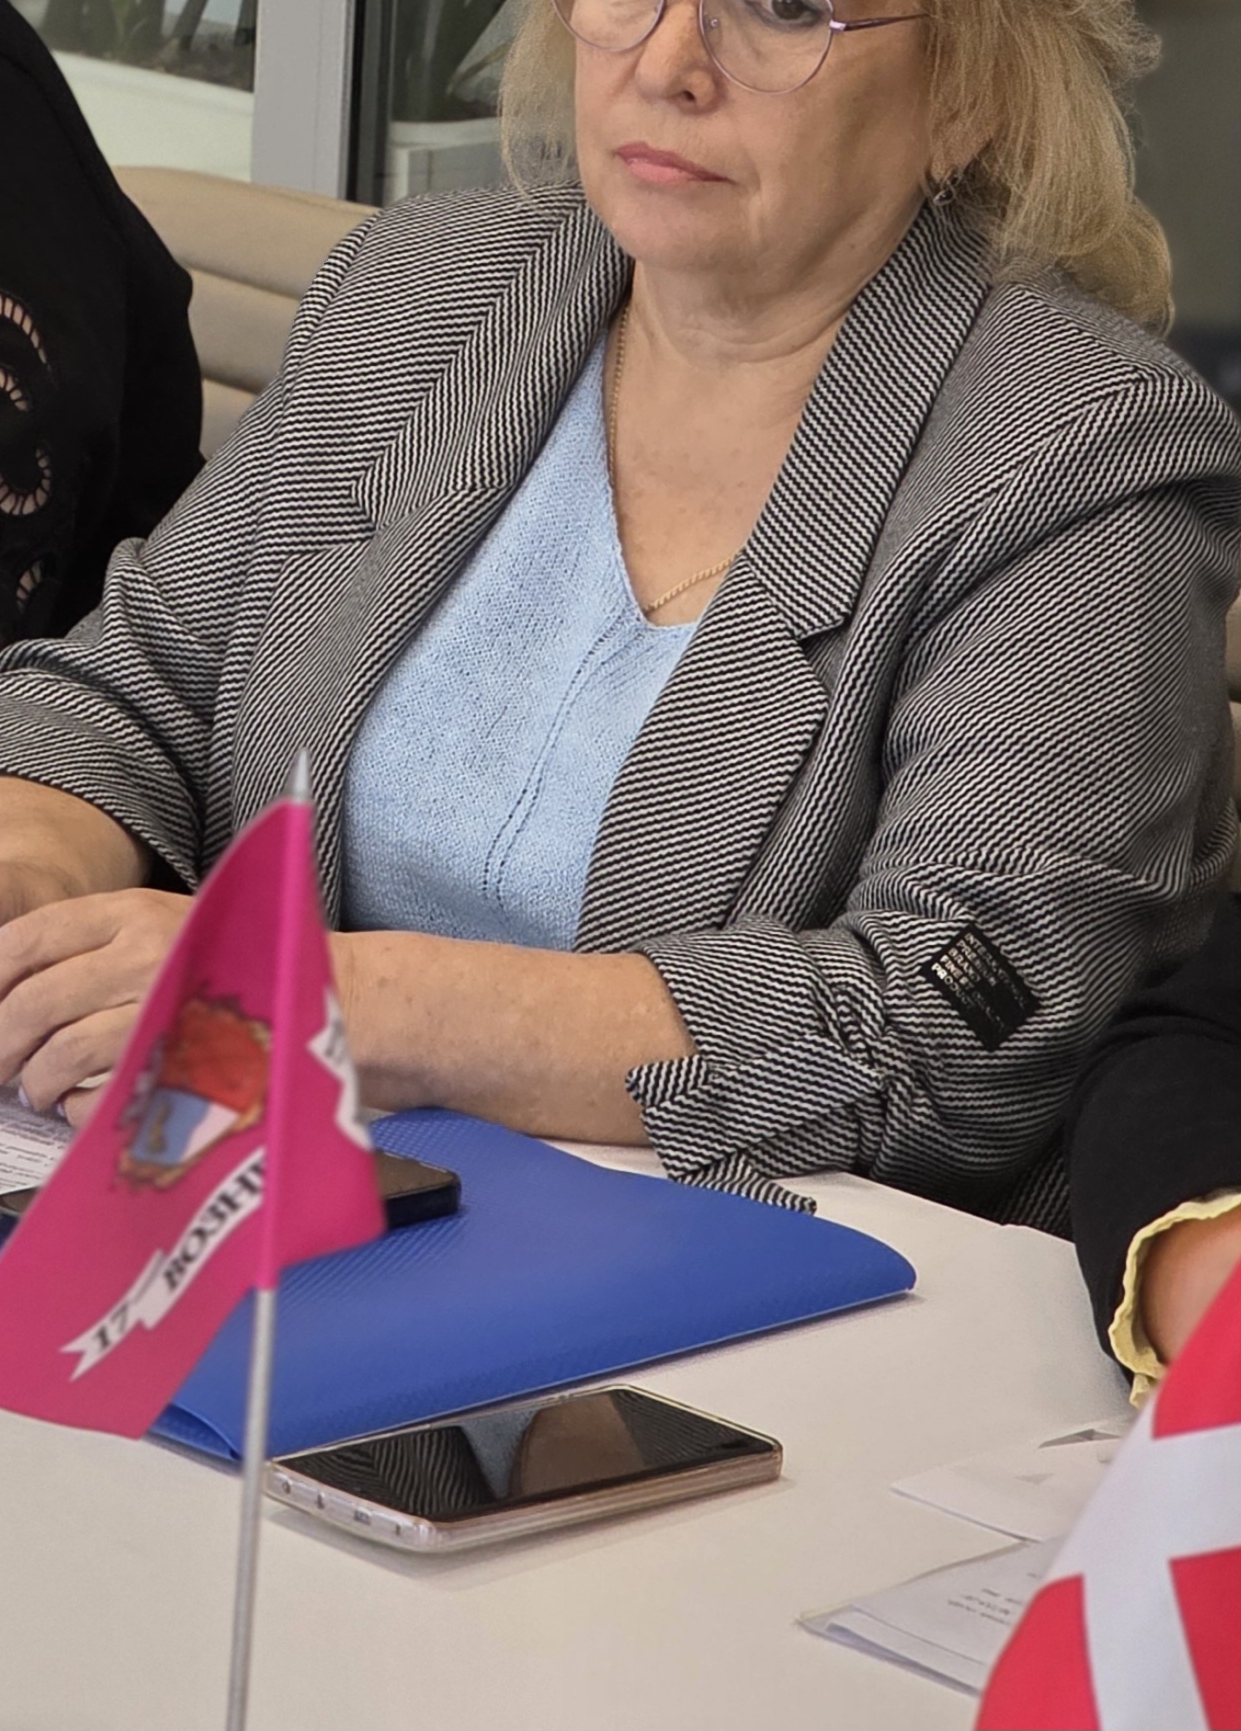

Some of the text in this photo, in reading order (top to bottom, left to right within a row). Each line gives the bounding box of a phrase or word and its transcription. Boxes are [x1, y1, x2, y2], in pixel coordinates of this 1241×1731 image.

[931, 962, 975, 1009] PRODUCT
[939, 954, 975, 991] FINEST
[947, 947, 981, 983] BRAND
[964, 932, 1025, 1010] INTERNATIL
